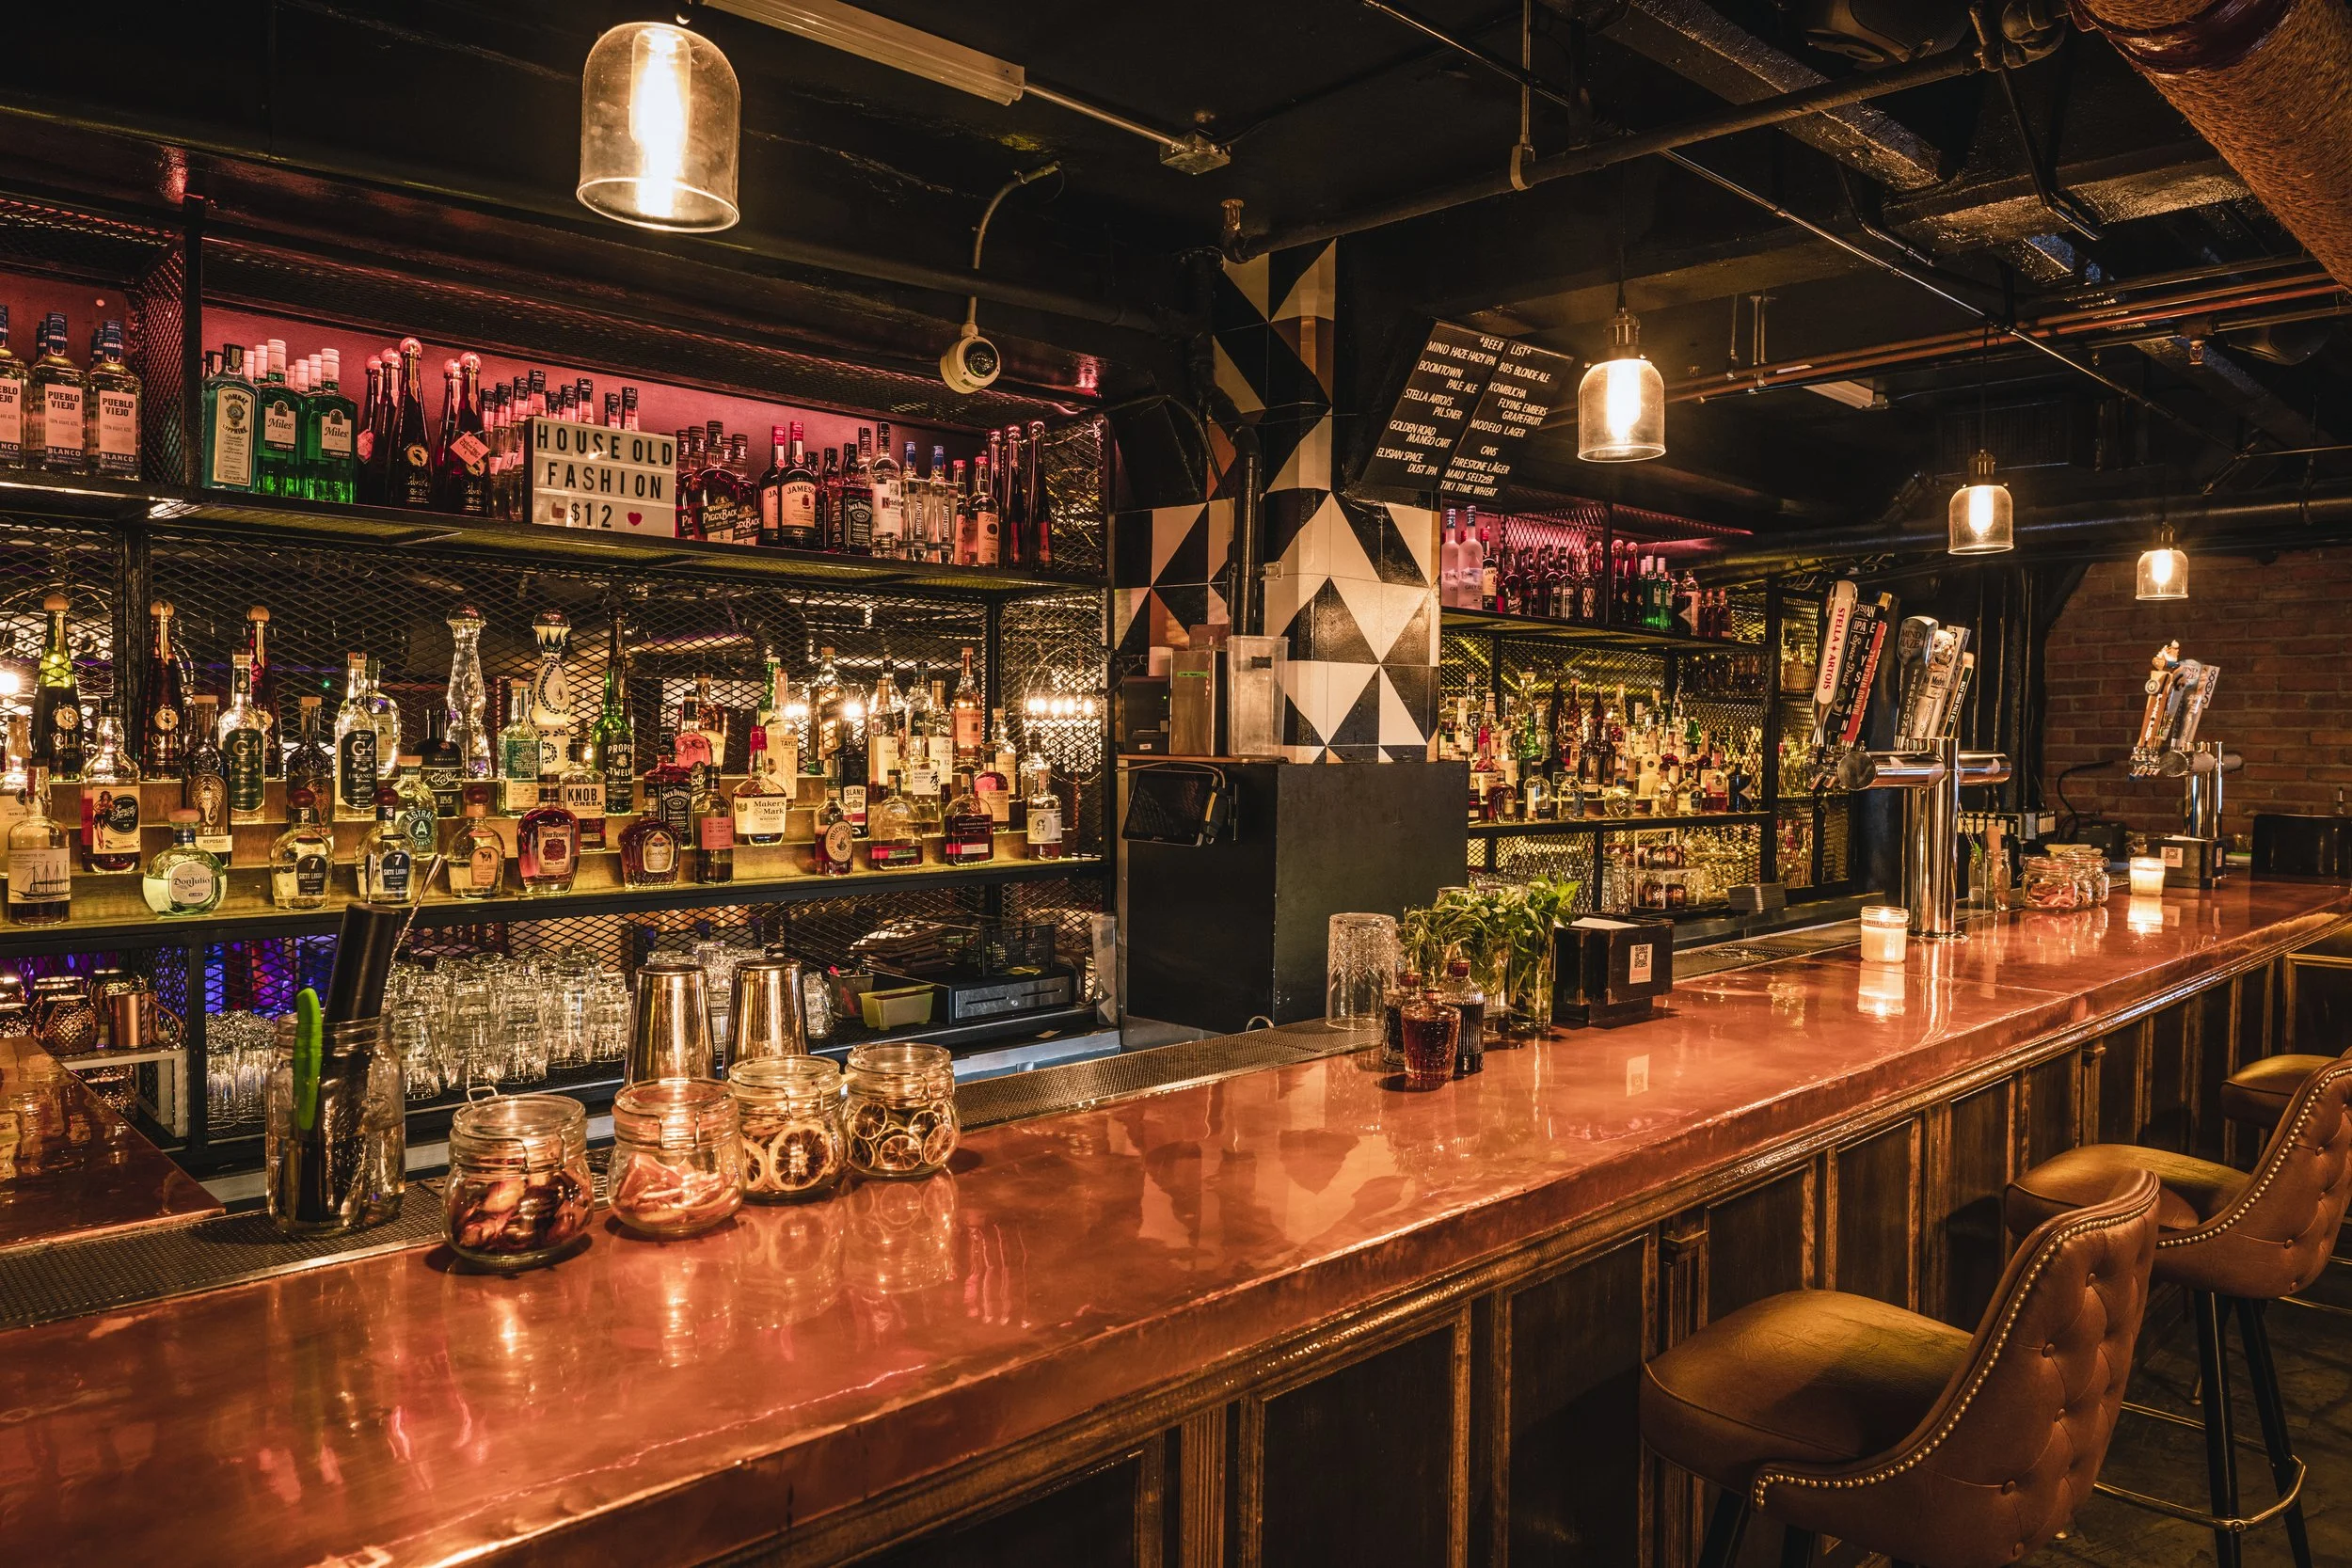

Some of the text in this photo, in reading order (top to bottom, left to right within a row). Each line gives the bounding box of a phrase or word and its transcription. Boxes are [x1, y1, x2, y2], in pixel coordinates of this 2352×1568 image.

[1426, 341, 1497, 366] MIND HAZE HAZY IPA
[1418, 360, 1464, 378] BOOMTOWN
[1498, 362, 1551, 383] 805 BLONDE ALE
[1446, 379, 1478, 394] PALE ALE
[1487, 382, 1527, 399] KOMBUCHA
[48, 390, 80, 403] PUEBLO
[102, 397, 134, 409] PUEBLO
[224, 393, 248, 405] BOMBAY
[1404, 388, 1454, 406] STELLA ARTOIS
[51, 400, 75, 411] VIEJO
[105, 406, 129, 417] VIEJO
[1433, 406, 1463, 420] PILSNER
[1498, 398, 1549, 417] FLYING EMBERS
[267, 418, 293, 430] Miles
[1502, 410, 1543, 426] GRAPEFRUIT
[222, 423, 248, 435] SAPPHIRE
[324, 426, 348, 437] Miles
[1390, 420, 1437, 436] GOLDEN ROAD
[1470, 419, 1526, 438] MODELO LAGER
[537, 424, 672, 466] HOUSE OLD
[1406, 434, 1453, 448] MANGO CART
[48, 447, 81, 457] BLANCO
[101, 452, 135, 463] BLANCO
[1376, 447, 1424, 463] ELYSIAN SPACE
[1480, 445, 1499, 457] CANS
[1407, 464, 1438, 476] DUST IPA
[1451, 456, 1510, 475] FIRESTONE LAGER
[548, 462, 661, 499] FASHION
[1445, 468, 1495, 484] MAUI SELTZER
[1439, 480, 1498, 497] TIKI TIME WHEAT
[571, 502, 612, 529] $12
[1853, 620, 1867, 632] IPA
[1900, 629, 1922, 639] MIND
[1823, 607, 1845, 689] STELLA ARTOIS
[1899, 640, 1921, 649] HAZE
[1842, 634, 1862, 687] Space Dust
[1841, 622, 1877, 731] ELYSIAN
[1851, 649, 1876, 715] MANGO WHEAT ALE
[1900, 669, 1919, 734] FIRESTONE
[232, 739, 260, 756] G4
[351, 740, 374, 756] G4
[567, 788, 597, 801] KNOB
[662, 791, 674, 800] JACK
[405, 809, 435, 822] ASTRAL
[310, 858, 318, 869] 7
[394, 854, 402, 865] 7
[174, 877, 211, 888] Don Julio
